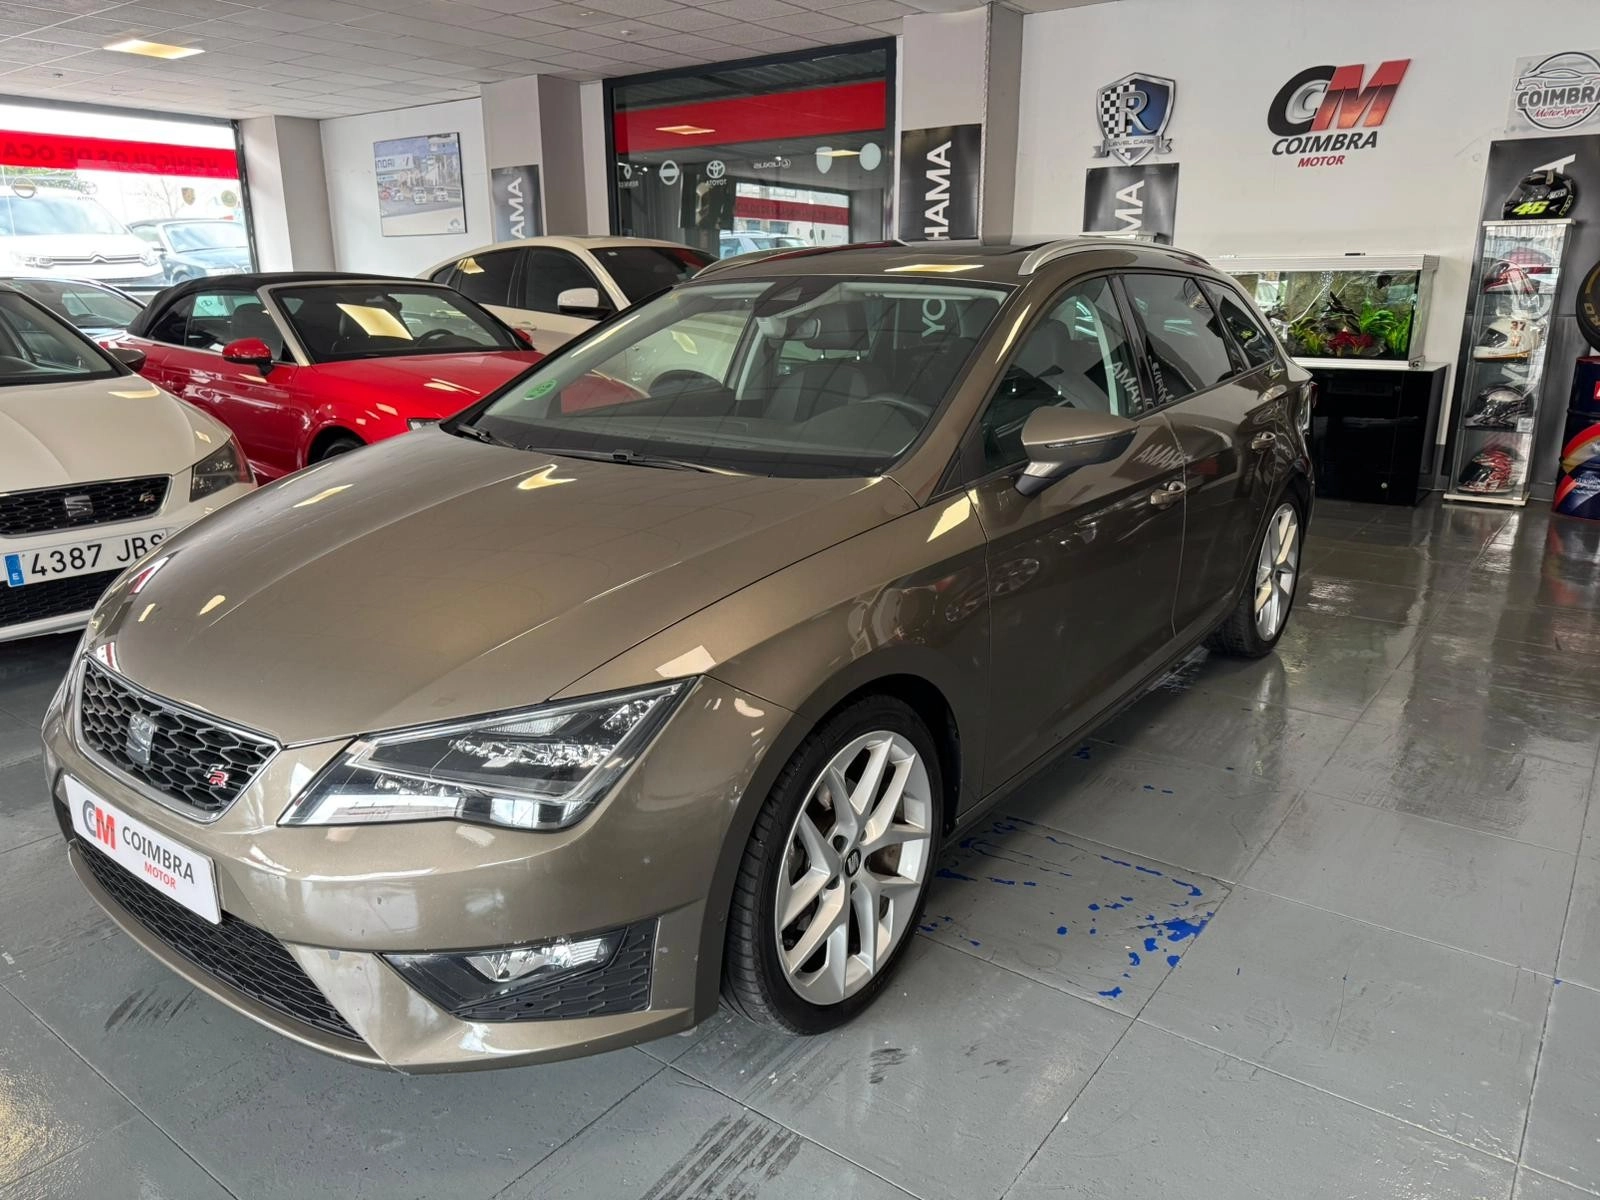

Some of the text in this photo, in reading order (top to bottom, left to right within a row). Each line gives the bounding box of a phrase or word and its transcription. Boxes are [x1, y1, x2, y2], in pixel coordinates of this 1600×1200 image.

[1118, 91, 1158, 133] R
[1267, 58, 1411, 136] CM
[1271, 131, 1378, 155] COIMBRA
[1297, 155, 1346, 167] MOTOR
[507, 177, 526, 239] AMA
[924, 140, 952, 240] HAMA
[1114, 180, 1145, 232] MA
[1511, 201, 1550, 215] 46
[921, 297, 947, 338] YO
[1510, 321, 1527, 331] 37
[12, 572, 20, 580] E
[31, 543, 103, 576] 4387
[82, 799, 196, 885] CM COIMBRA
[144, 862, 177, 890] MOTOR
